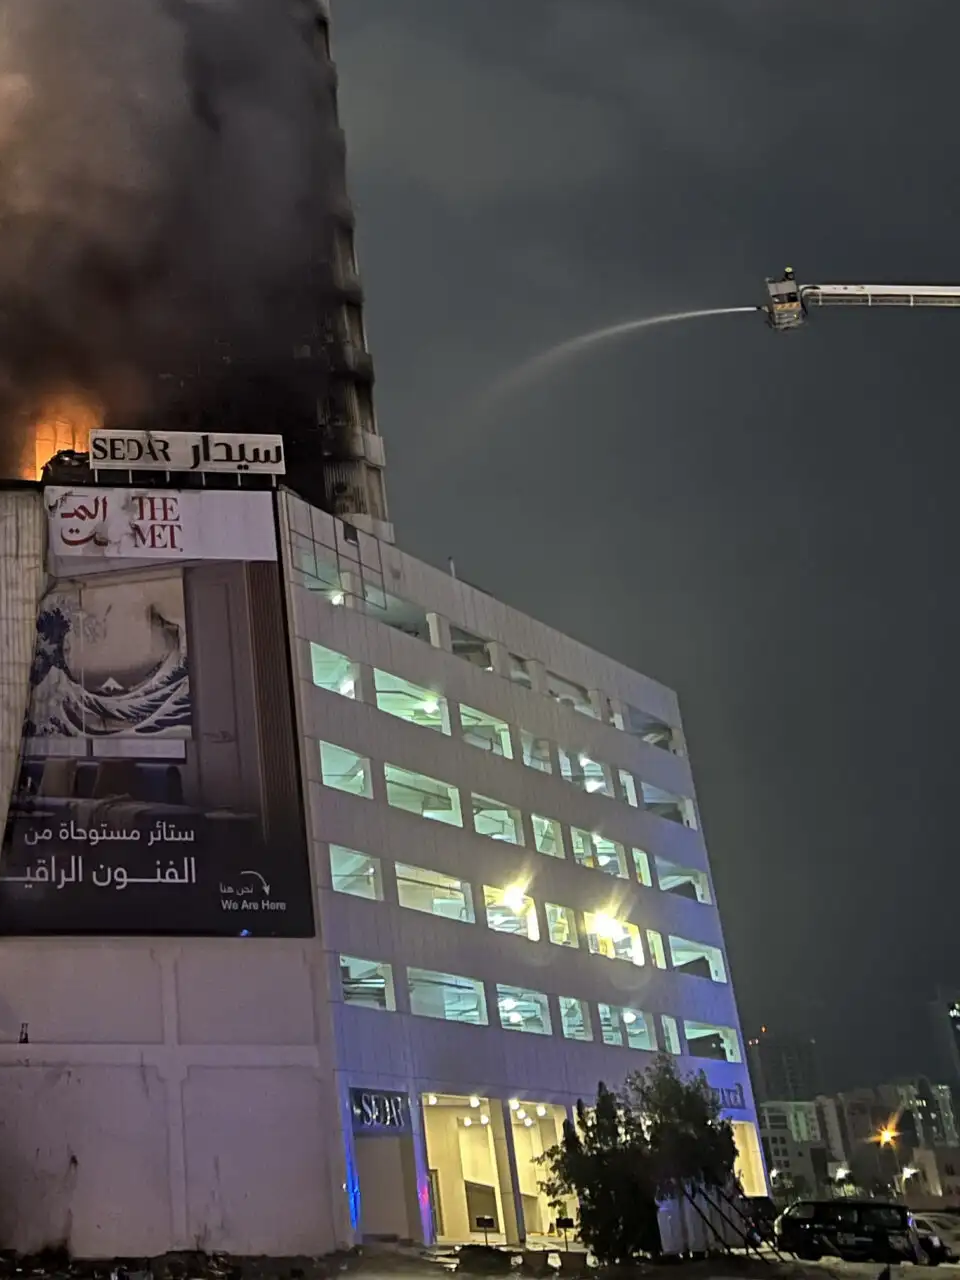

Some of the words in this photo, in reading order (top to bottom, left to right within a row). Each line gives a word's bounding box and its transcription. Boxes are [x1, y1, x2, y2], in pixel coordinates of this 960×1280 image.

[92, 437, 172, 462] SEDAR
[190, 435, 282, 470] سيدار
[131, 496, 180, 521] THE
[24, 826, 53, 846] من
[59, 820, 141, 846] مستوحاة
[148, 821, 195, 846] ستائر
[221, 899, 239, 911] We
[241, 899, 259, 911] Are
[261, 899, 287, 911] Here
